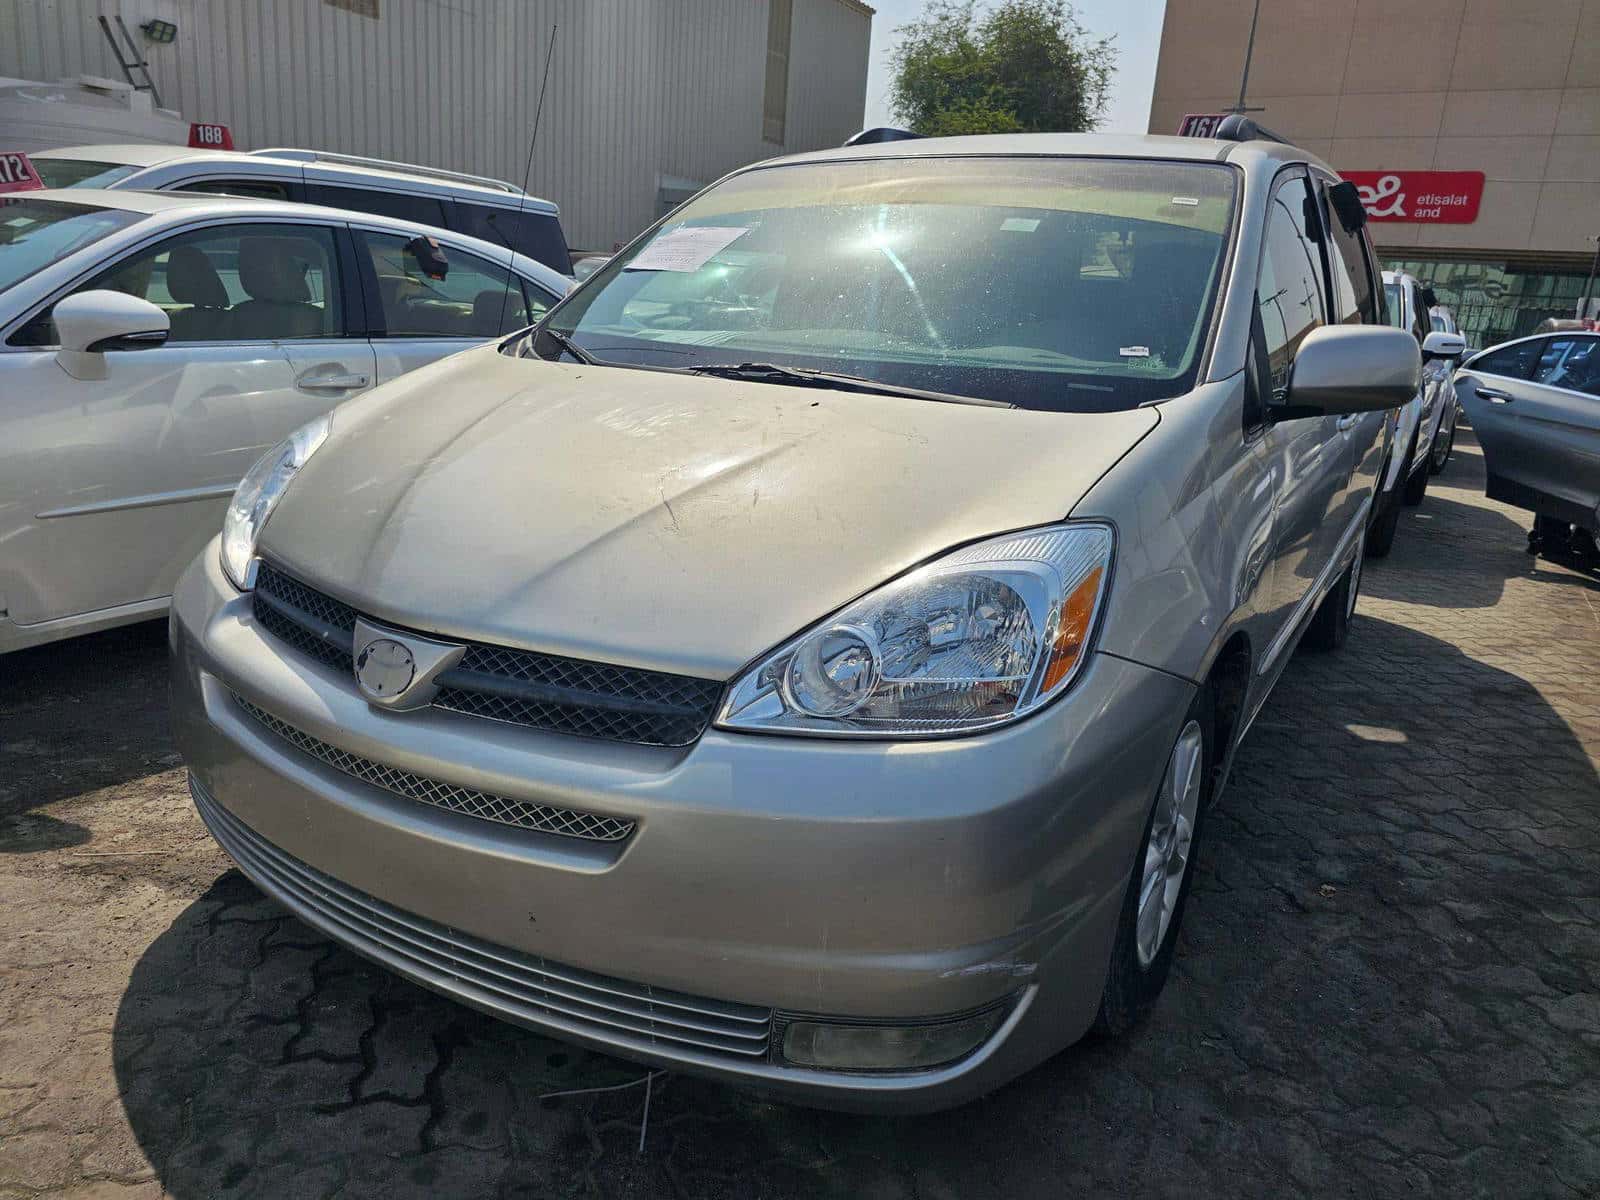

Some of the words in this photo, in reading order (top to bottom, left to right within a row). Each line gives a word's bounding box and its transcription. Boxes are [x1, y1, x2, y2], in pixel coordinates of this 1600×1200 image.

[198, 126, 223, 144] 188
[1416, 194, 1468, 206] etisalat
[1414, 207, 1441, 218] and
